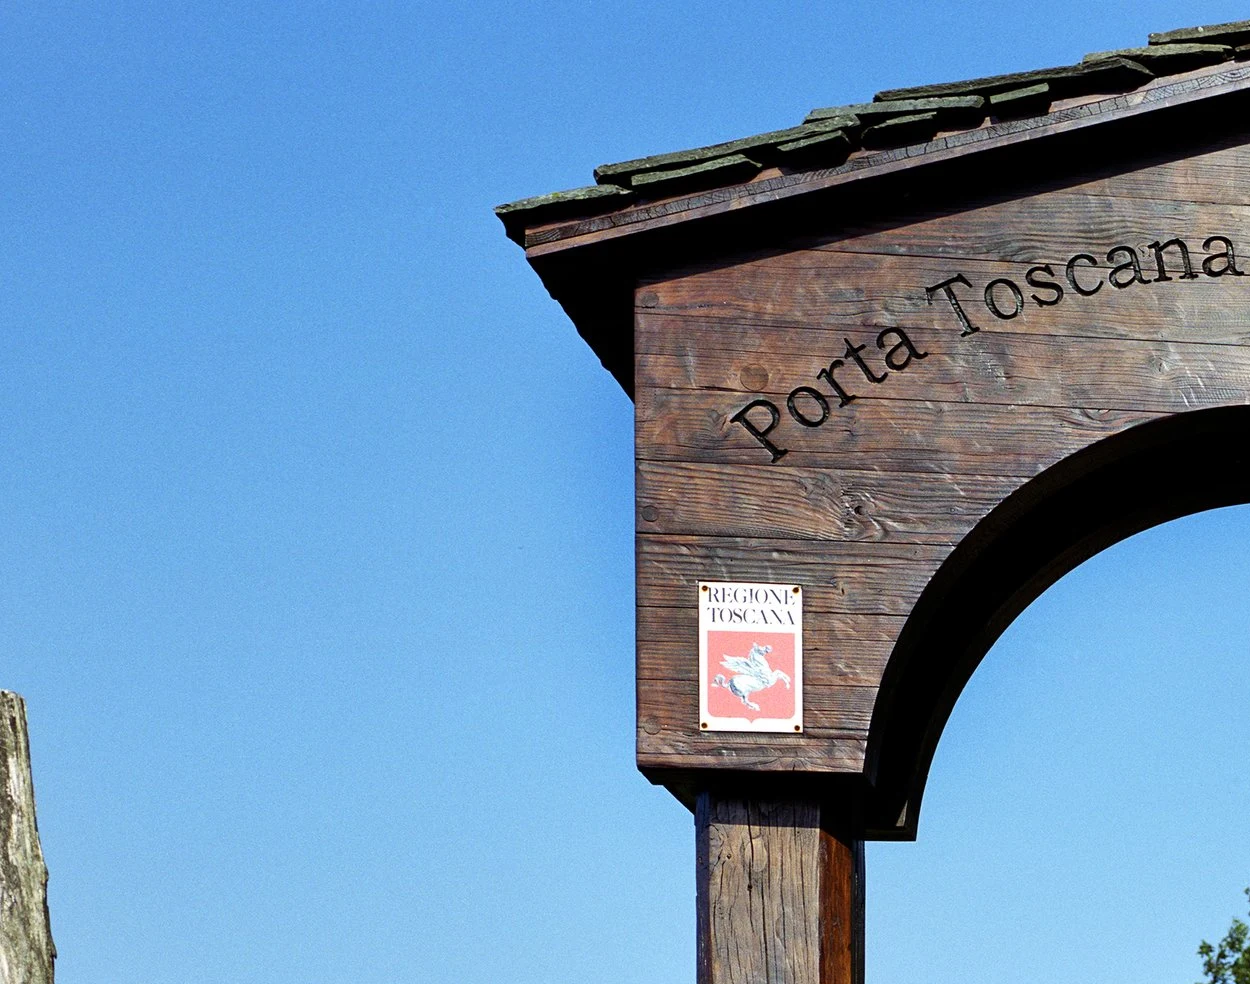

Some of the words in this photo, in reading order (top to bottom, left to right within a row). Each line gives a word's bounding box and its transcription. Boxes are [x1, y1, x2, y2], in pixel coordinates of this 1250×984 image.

[731, 326, 928, 463] Porta
[925, 235, 1245, 338] Toscana
[708, 587, 795, 605] REGIONE
[707, 607, 796, 625] TOSCANA
